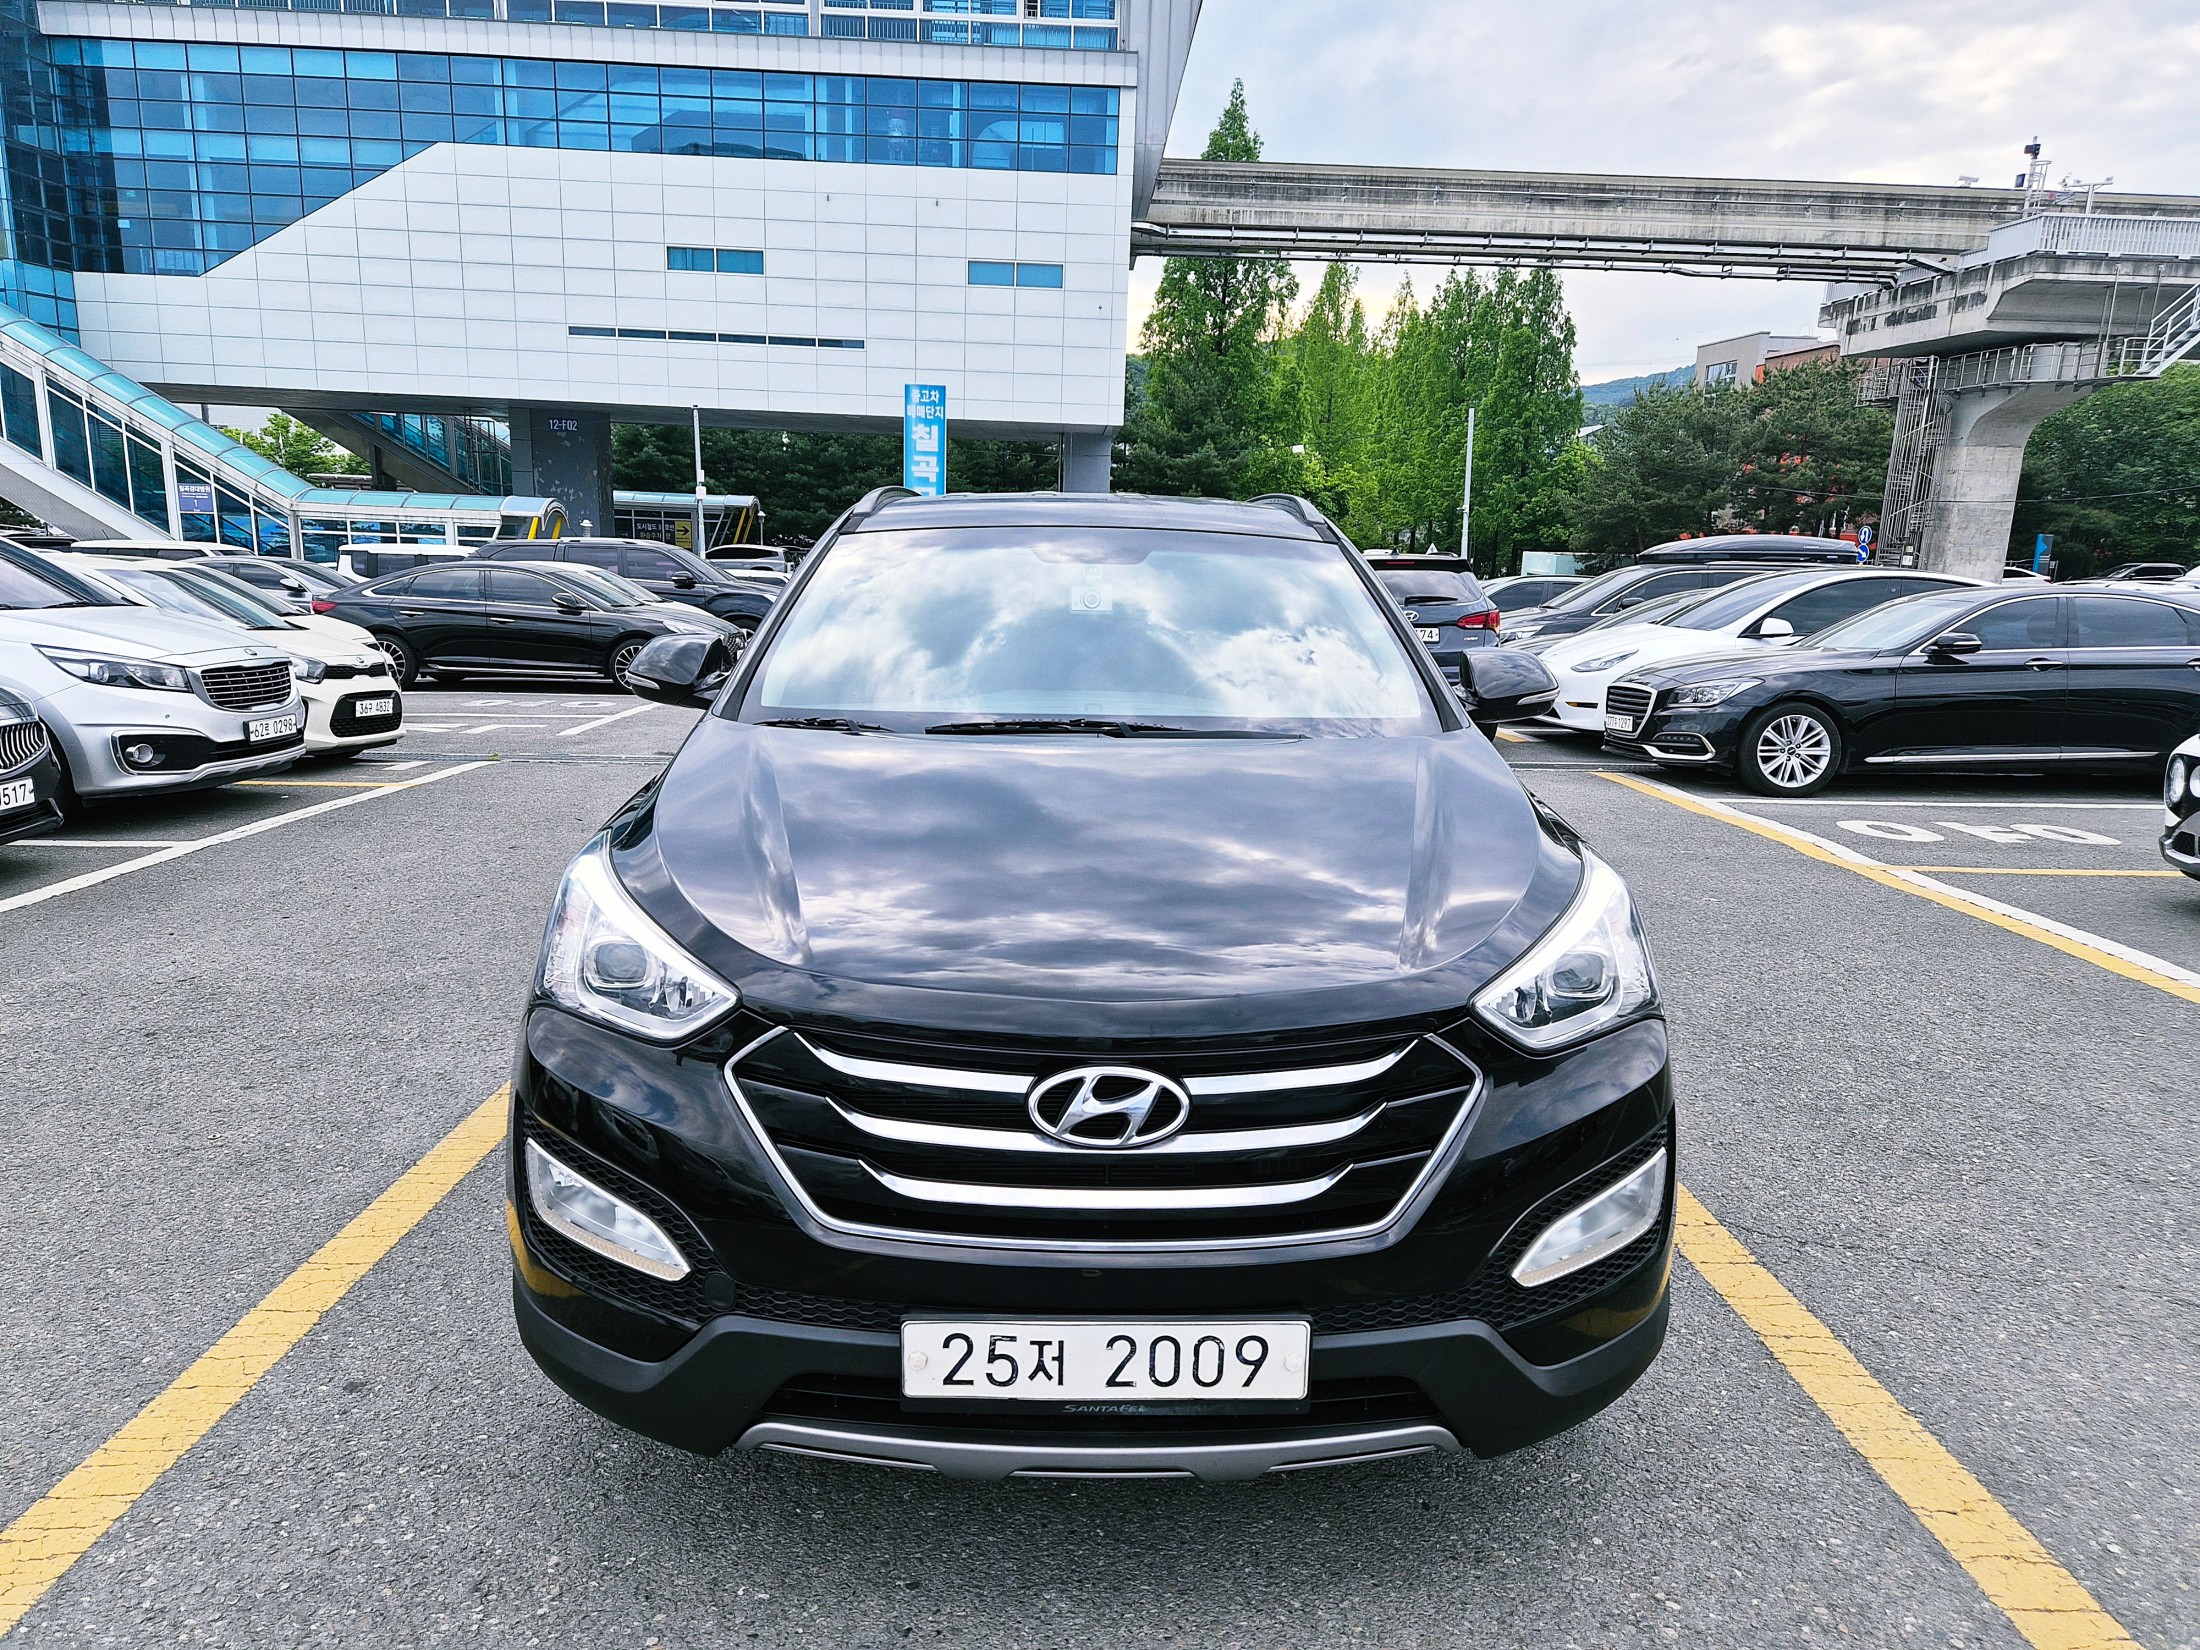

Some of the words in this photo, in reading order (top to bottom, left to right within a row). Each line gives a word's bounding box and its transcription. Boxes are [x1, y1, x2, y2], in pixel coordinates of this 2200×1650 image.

[911, 389, 940, 404] 중고차
[907, 405, 944, 420] 매매단지
[549, 419, 578, 431] 12-F02
[911, 424, 939, 497] 칠곡
[1415, 629, 1434, 640] 74
[273, 718, 293, 735] 0298
[0, 783, 27, 806] 517
[941, 1333, 1065, 1387] 25저
[1104, 1335, 1269, 1388] 2009
